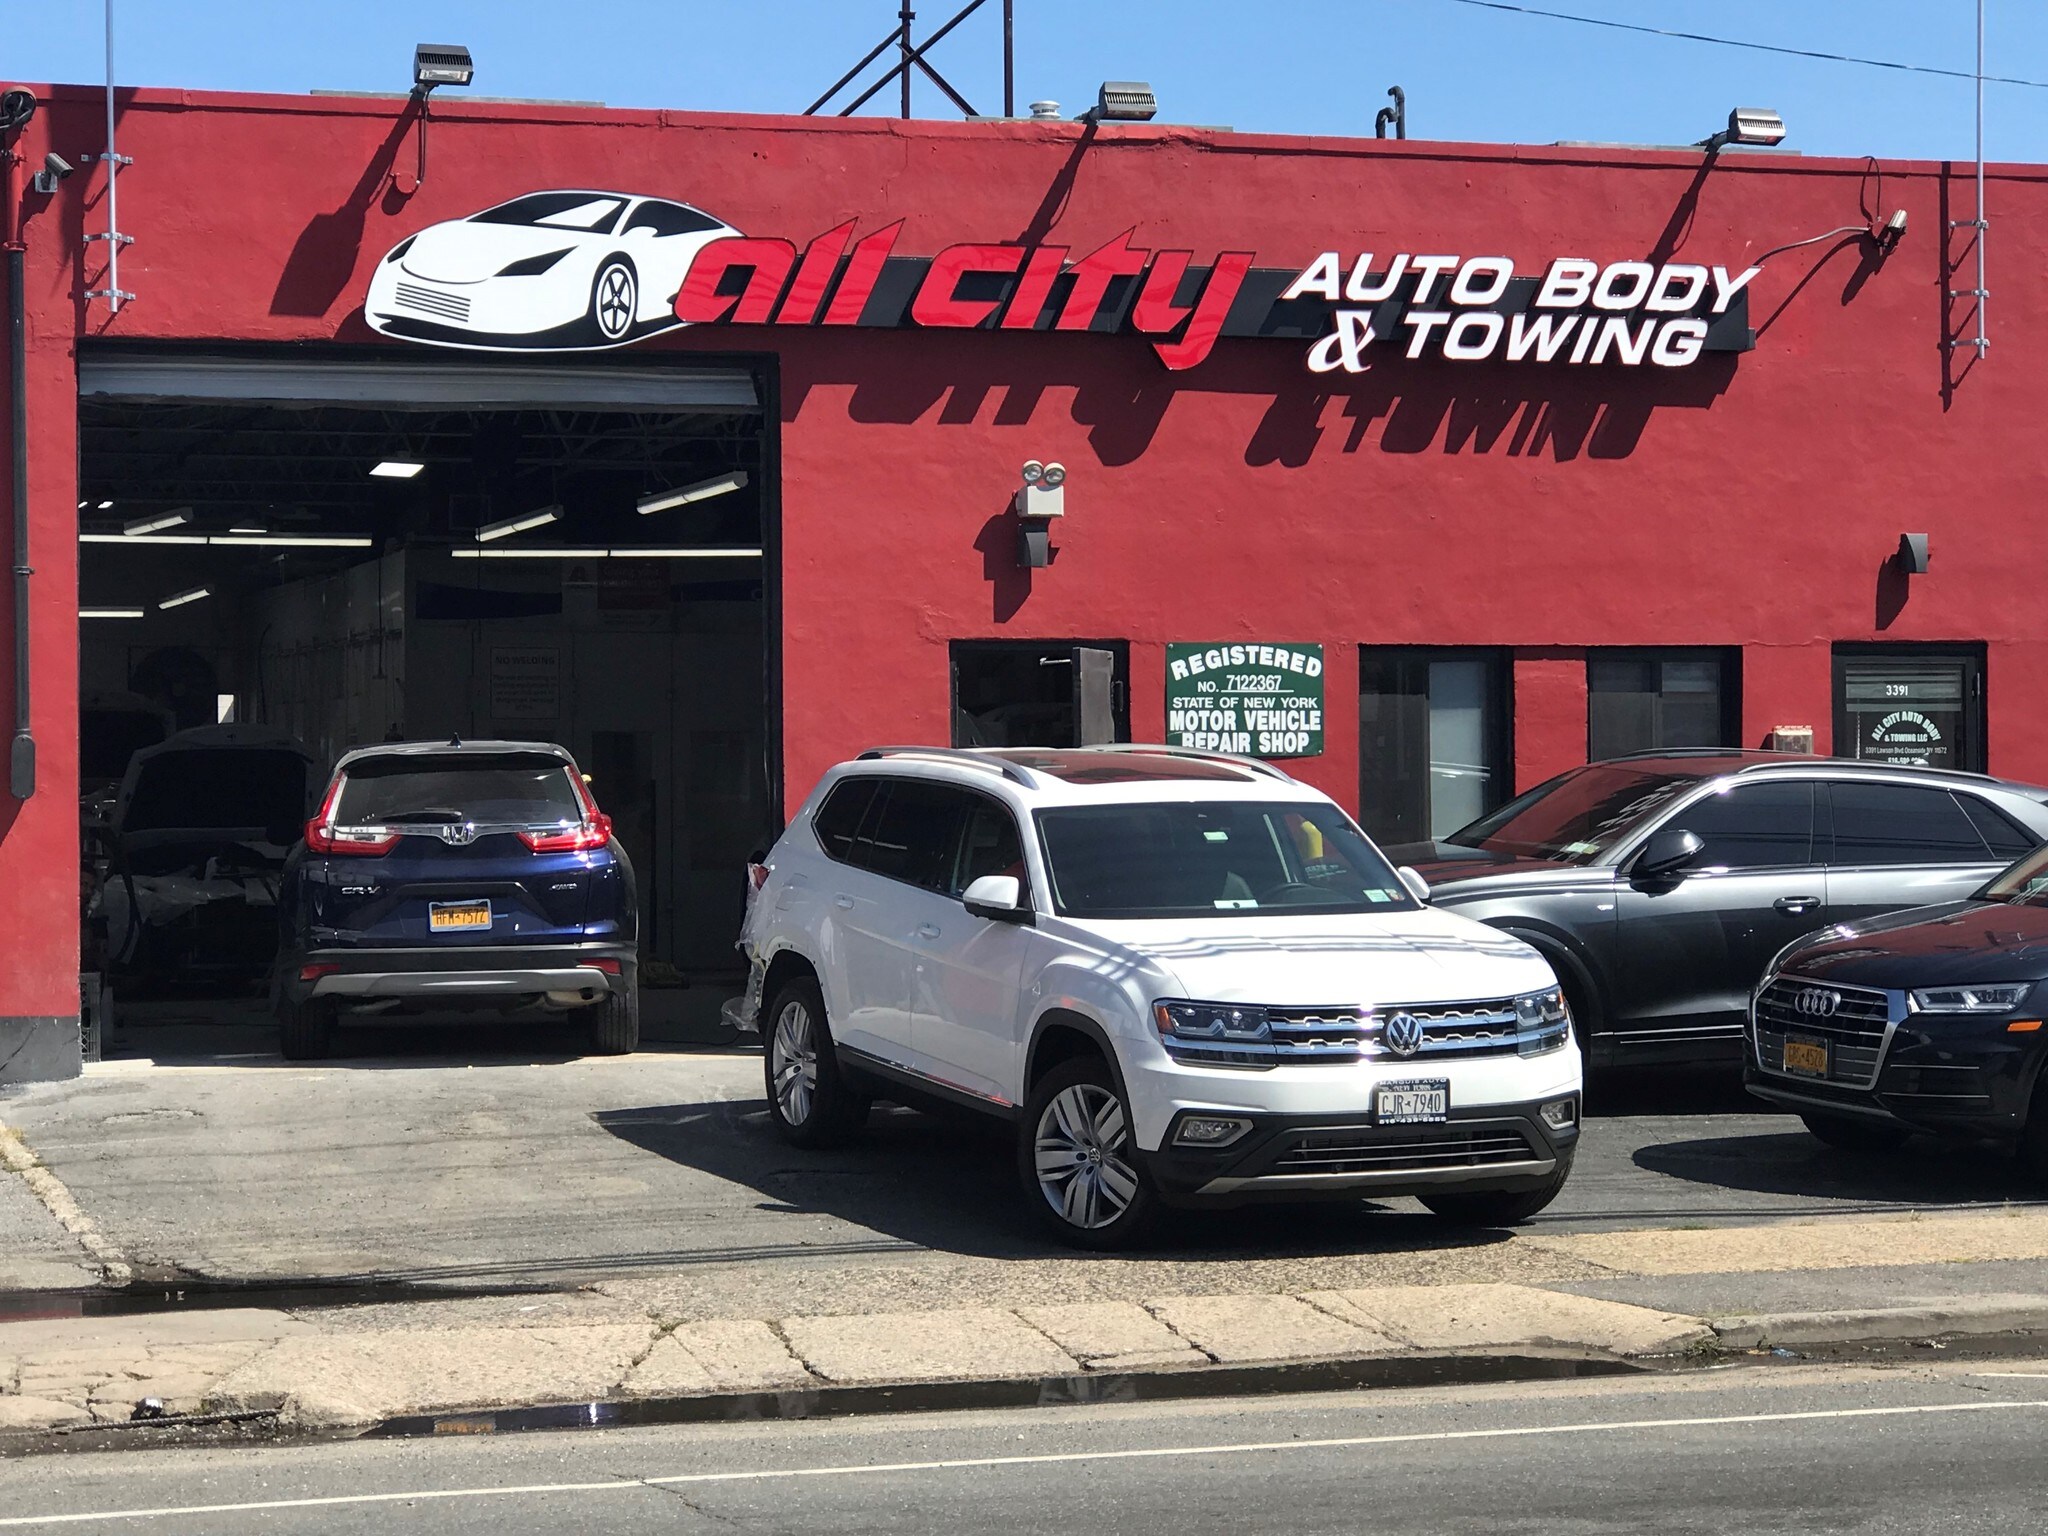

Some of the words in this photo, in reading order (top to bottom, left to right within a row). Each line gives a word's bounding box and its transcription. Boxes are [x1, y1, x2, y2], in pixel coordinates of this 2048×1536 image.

[673, 216, 906, 325] all
[911, 225, 1257, 370] city
[1276, 251, 1515, 306] AUTO
[1535, 257, 1763, 314] BODY
[1306, 309, 1376, 374] &
[1404, 311, 1709, 367] TOWING
[1170, 645, 1322, 681] REGISTERED
[1197, 681, 1219, 693] NO.
[1226, 674, 1282, 691] 7122367
[1886, 684, 1908, 696] 3391
[1172, 697, 1214, 709] STATE
[1219, 697, 1239, 709] OF
[1244, 697, 1276, 709] NEW
[1280, 697, 1318, 709] YORK
[1169, 709, 1237, 732] MOTOR
[1244, 709, 1322, 731] VEHICLE
[1871, 723, 1886, 742] ALL
[1882, 711, 1901, 728] CITY
[1901, 710, 1924, 725] AUTO
[1922, 718, 1942, 741] BODY
[1181, 732, 1251, 753] REPAIR
[1258, 732, 1310, 754] SHOP
[1890, 733, 1917, 742] TOWING
[1917, 733, 1928, 742] LLC
